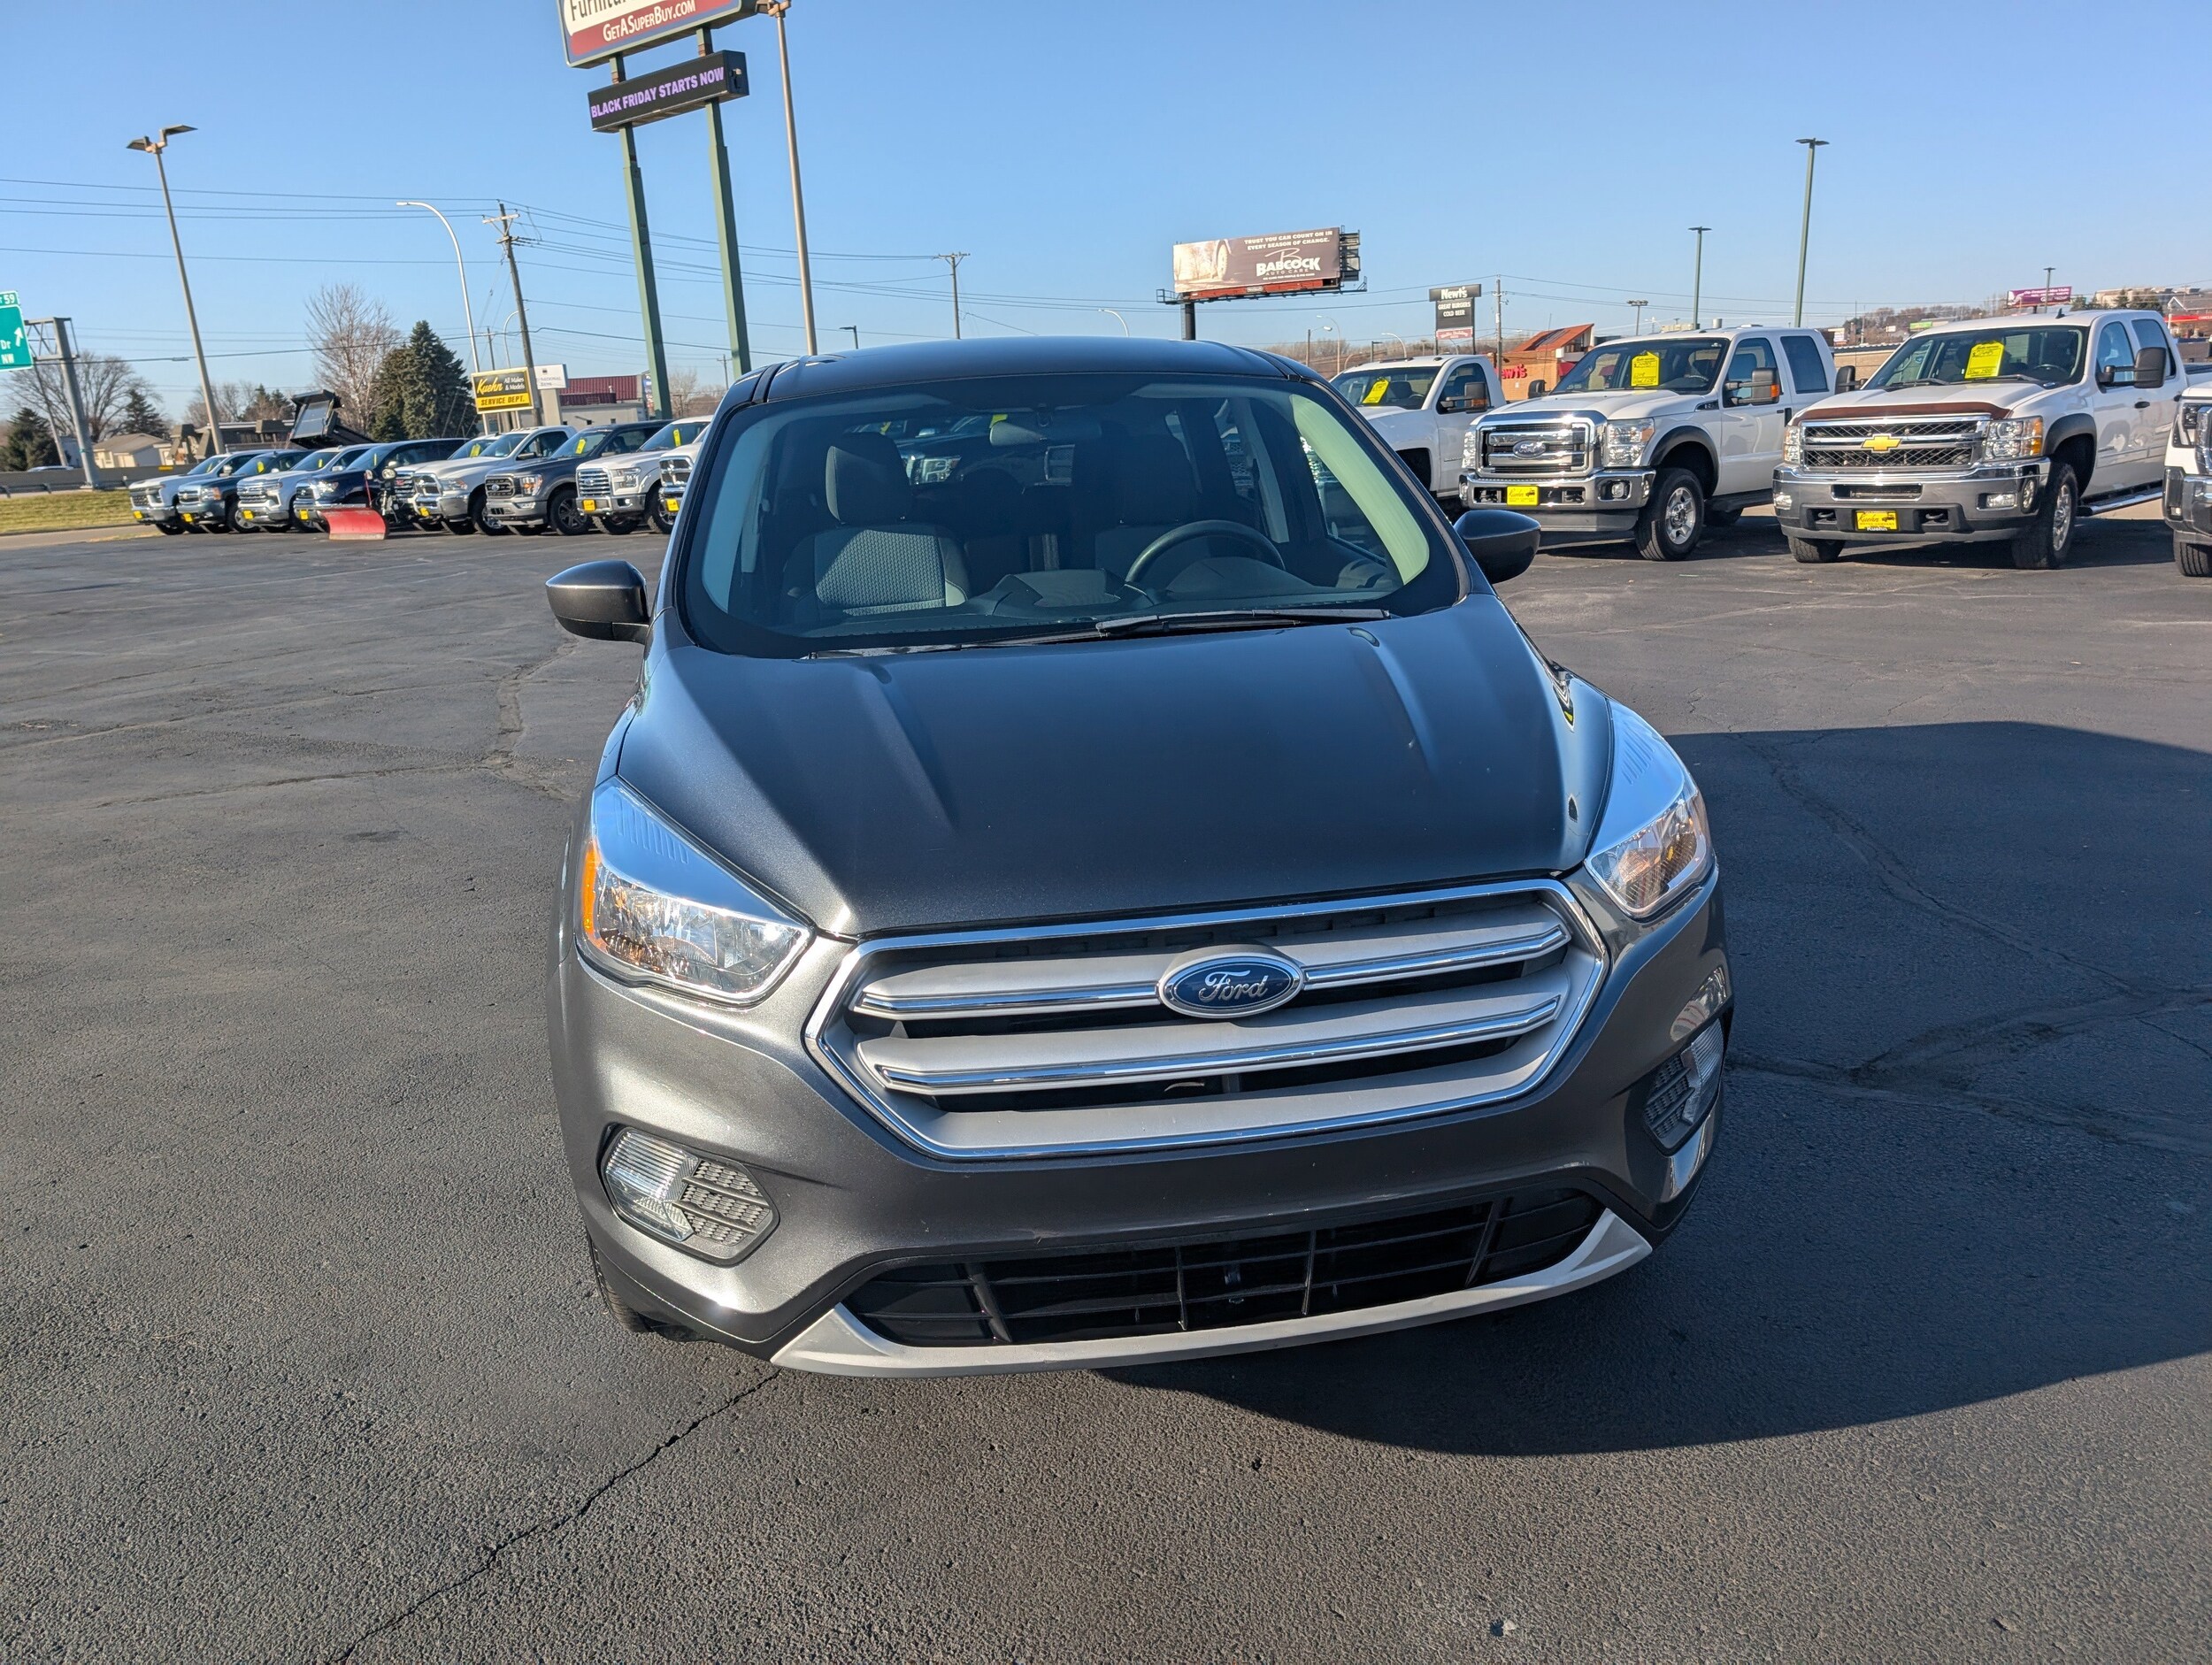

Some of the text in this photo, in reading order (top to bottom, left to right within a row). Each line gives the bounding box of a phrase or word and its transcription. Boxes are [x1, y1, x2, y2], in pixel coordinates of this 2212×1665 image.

[590, 66, 725, 119] BLACK FRIDAY STARTS NOW
[1256, 257, 1321, 277] BABCOCK
[4, 294, 15, 304] 59
[1441, 286, 1468, 299] Newt's
[1, 340, 12, 349] Dr
[1, 353, 15, 364] NW
[476, 377, 503, 395] Kuehn
[481, 395, 525, 405] SERVICE DEPT.
[1198, 970, 1269, 1002] Ford
